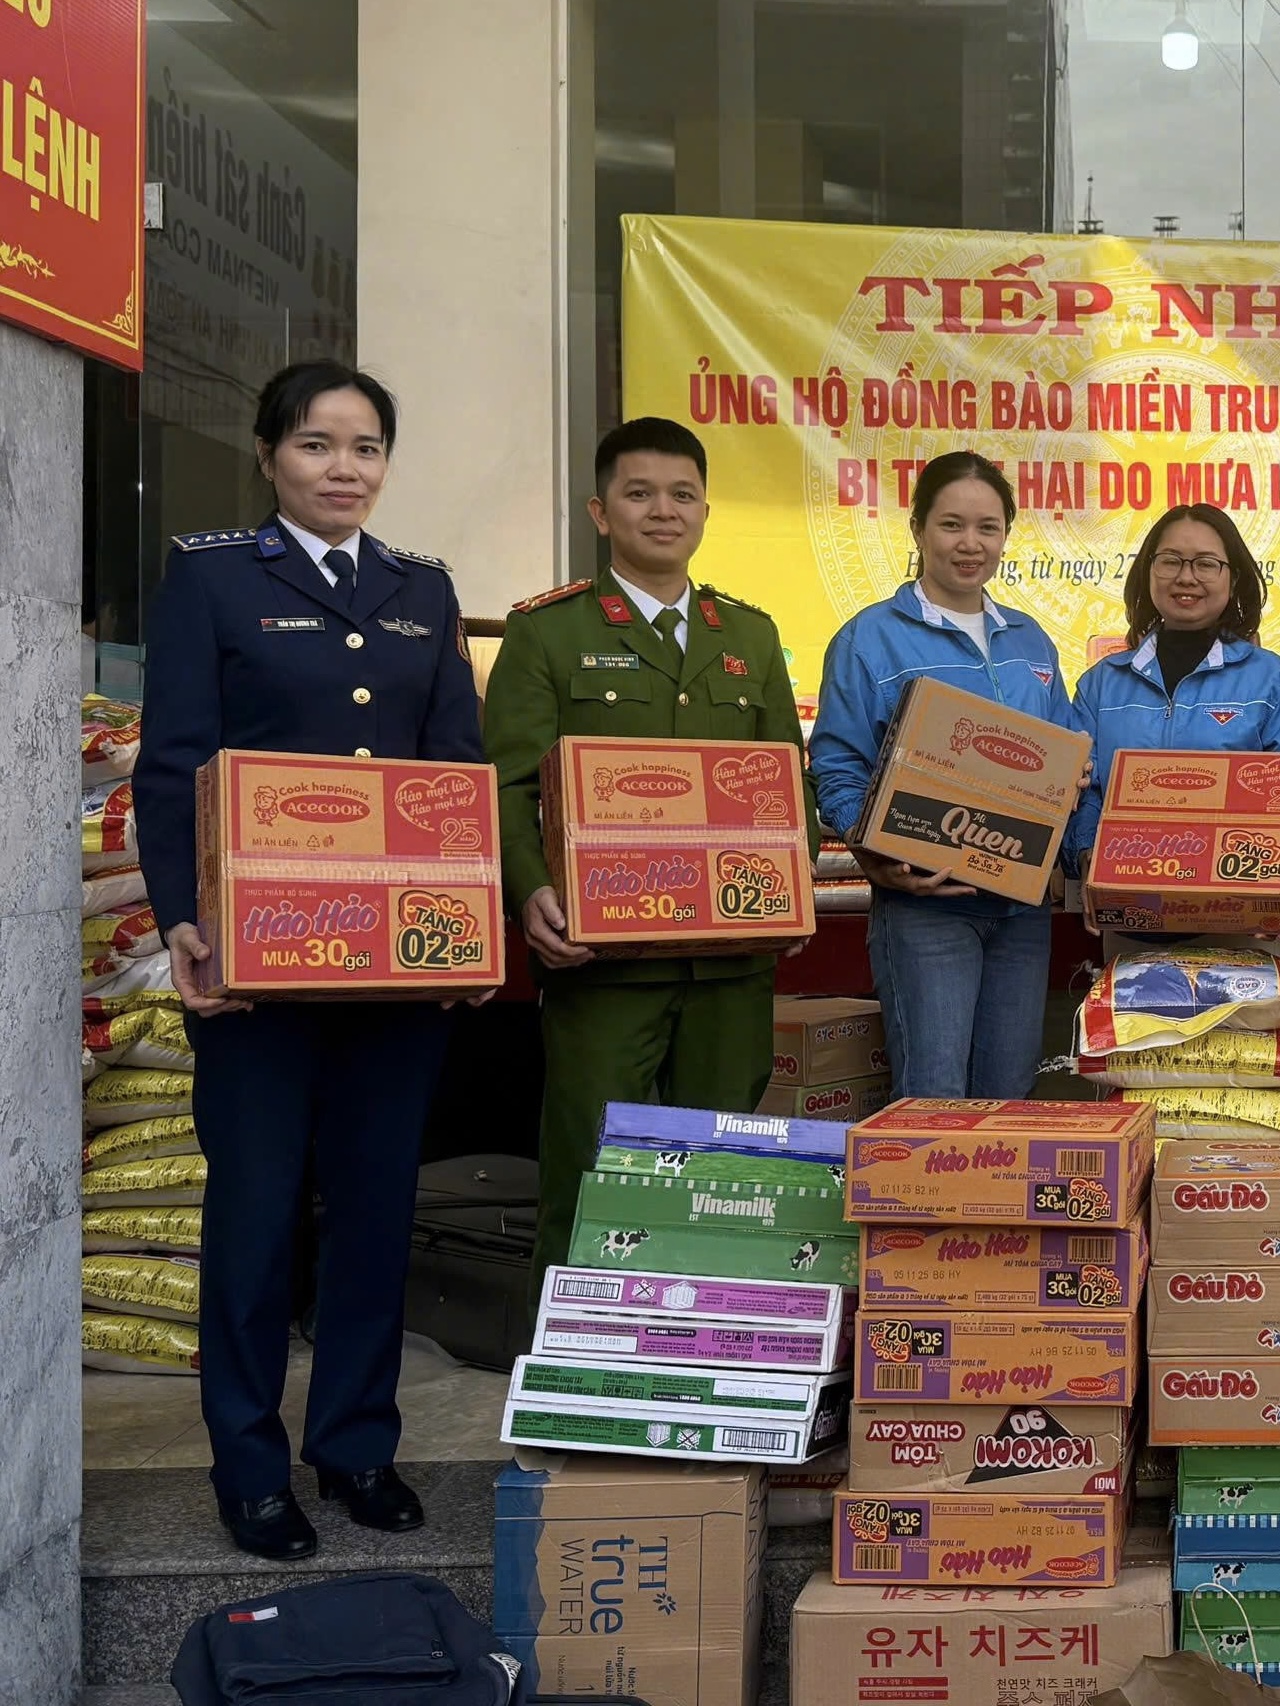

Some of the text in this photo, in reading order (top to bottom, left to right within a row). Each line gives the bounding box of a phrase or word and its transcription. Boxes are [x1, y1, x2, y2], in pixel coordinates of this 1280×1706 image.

[3, 76, 100, 222] LỆNH
[858, 254, 1113, 335] TIẾP
[690, 356, 777, 424] ỦNG
[794, 366, 848, 438] HỘ
[862, 362, 976, 429] ĐỒNG
[992, 370, 1072, 431] BÀO
[1087, 367, 1191, 432] MIỀN
[838, 458, 877, 518] BỊ
[1019, 461, 1084, 521] HẠI
[1100, 462, 1150, 510] DO
[1167, 457, 1256, 508] MƯA
[1031, 551, 1052, 579] từ
[1059, 553, 1107, 585] ngày
[976, 724, 1048, 758] Cook happiness
[614, 763, 691, 778] Cook happiness
[279, 782, 370, 800] Cook happiness
[440, 818, 482, 850] 25
[941, 806, 1024, 860] Quen
[967, 854, 981, 865] Bò
[1115, 859, 1196, 880] MUA 30 gói
[731, 864, 773, 890] TẶNG
[602, 895, 696, 922] MUA 30 gói
[720, 884, 789, 915] 02 gói
[244, 893, 380, 943] Hảo Hảo
[415, 907, 464, 936] TẶNG
[262, 939, 371, 972] MUA 30 gói
[400, 928, 480, 967] 02 gói
[715, 1113, 790, 1137] Vinamilk
[925, 1140, 1016, 1175] Hảo Hảo
[691, 1192, 776, 1218] Vinamilk
[902, 1184, 911, 1193] 25
[929, 1187, 940, 1196] HY
[868, 1421, 962, 1439] CHUA CAY
[1009, 1410, 1046, 1433] 90
[894, 1445, 937, 1464] TÔM
[974, 1436, 1096, 1468] KOKOMI
[639, 1536, 668, 1592] TH
[559, 1538, 584, 1635] WATER
[590, 1534, 634, 1634] true
[861, 1623, 1099, 1668] 유자 치즈케
[1036, 1678, 1059, 1689] 치즈
